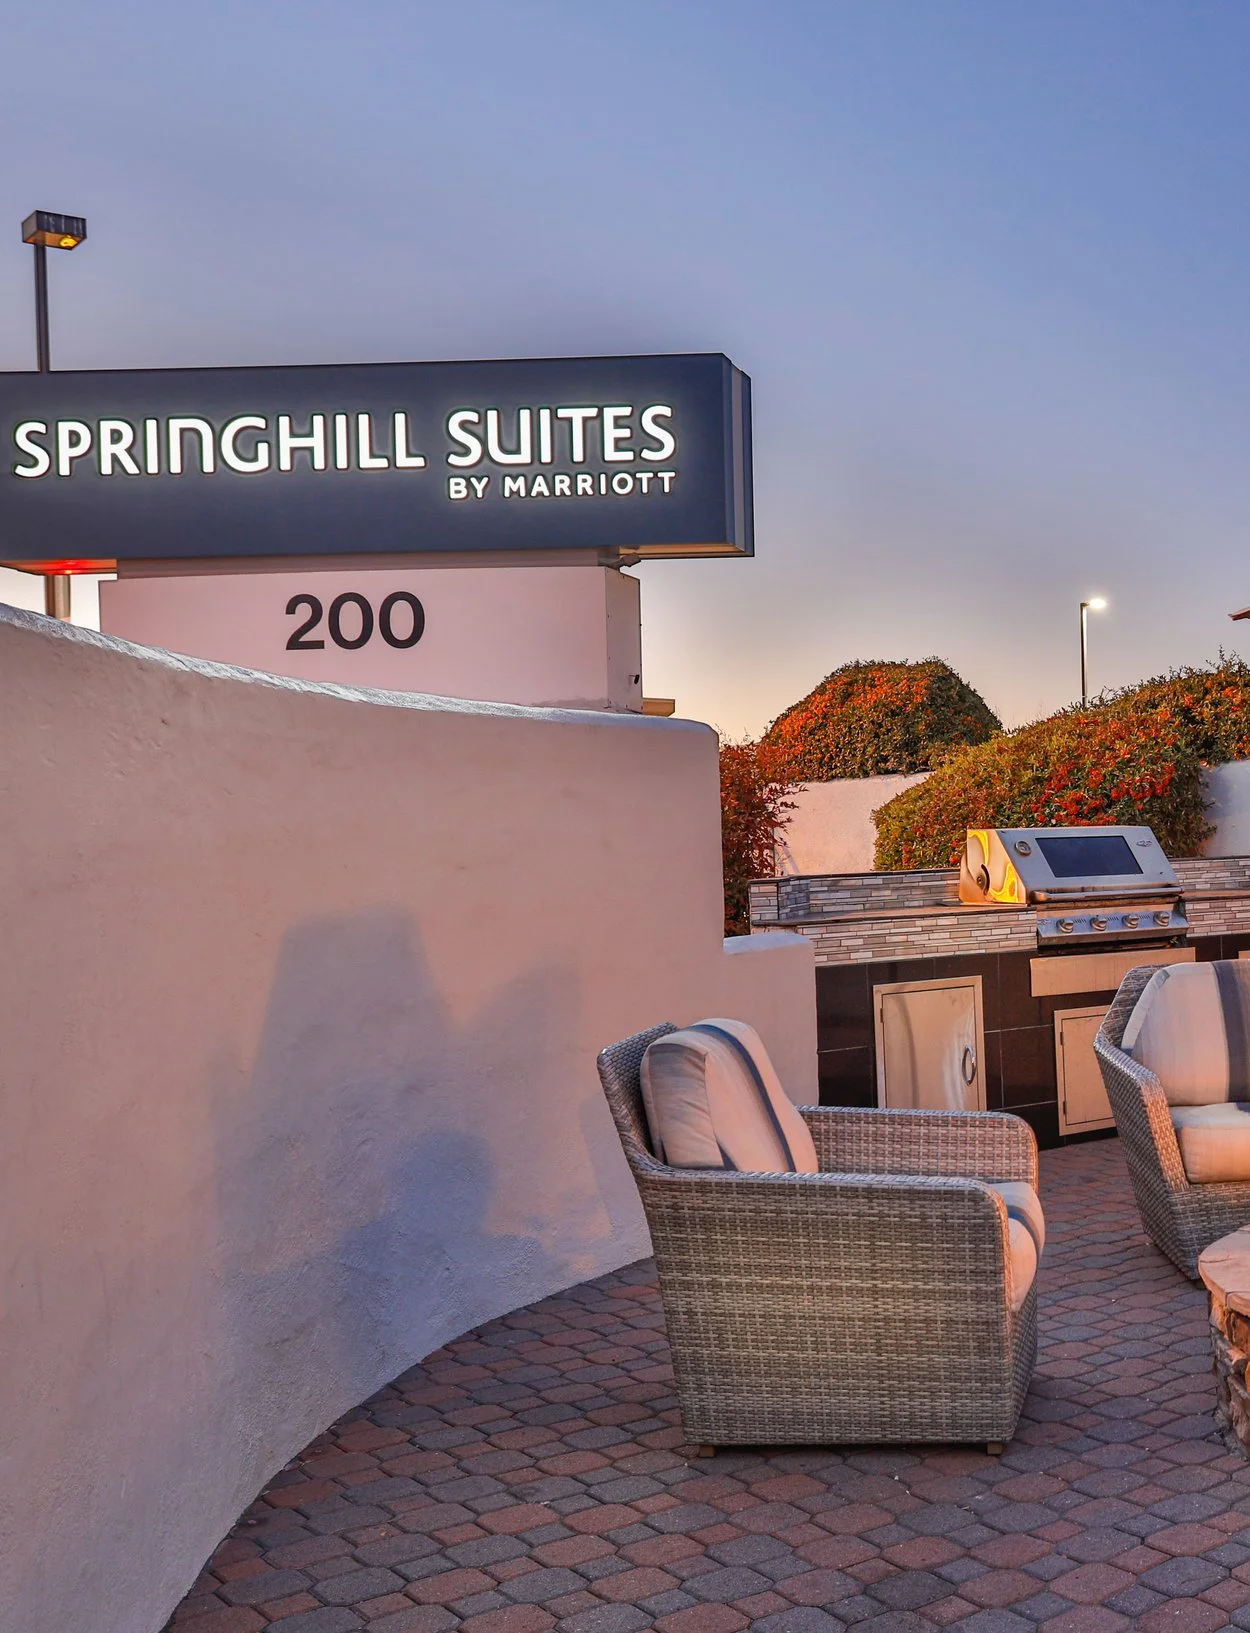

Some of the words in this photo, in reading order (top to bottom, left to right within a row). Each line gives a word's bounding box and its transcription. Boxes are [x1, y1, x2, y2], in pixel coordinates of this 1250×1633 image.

[14, 412, 426, 478] SPRINGHILL
[447, 404, 676, 466] SUITES
[448, 476, 490, 500] BY
[503, 471, 677, 498] MARRIOTT
[285, 590, 426, 651] 200
